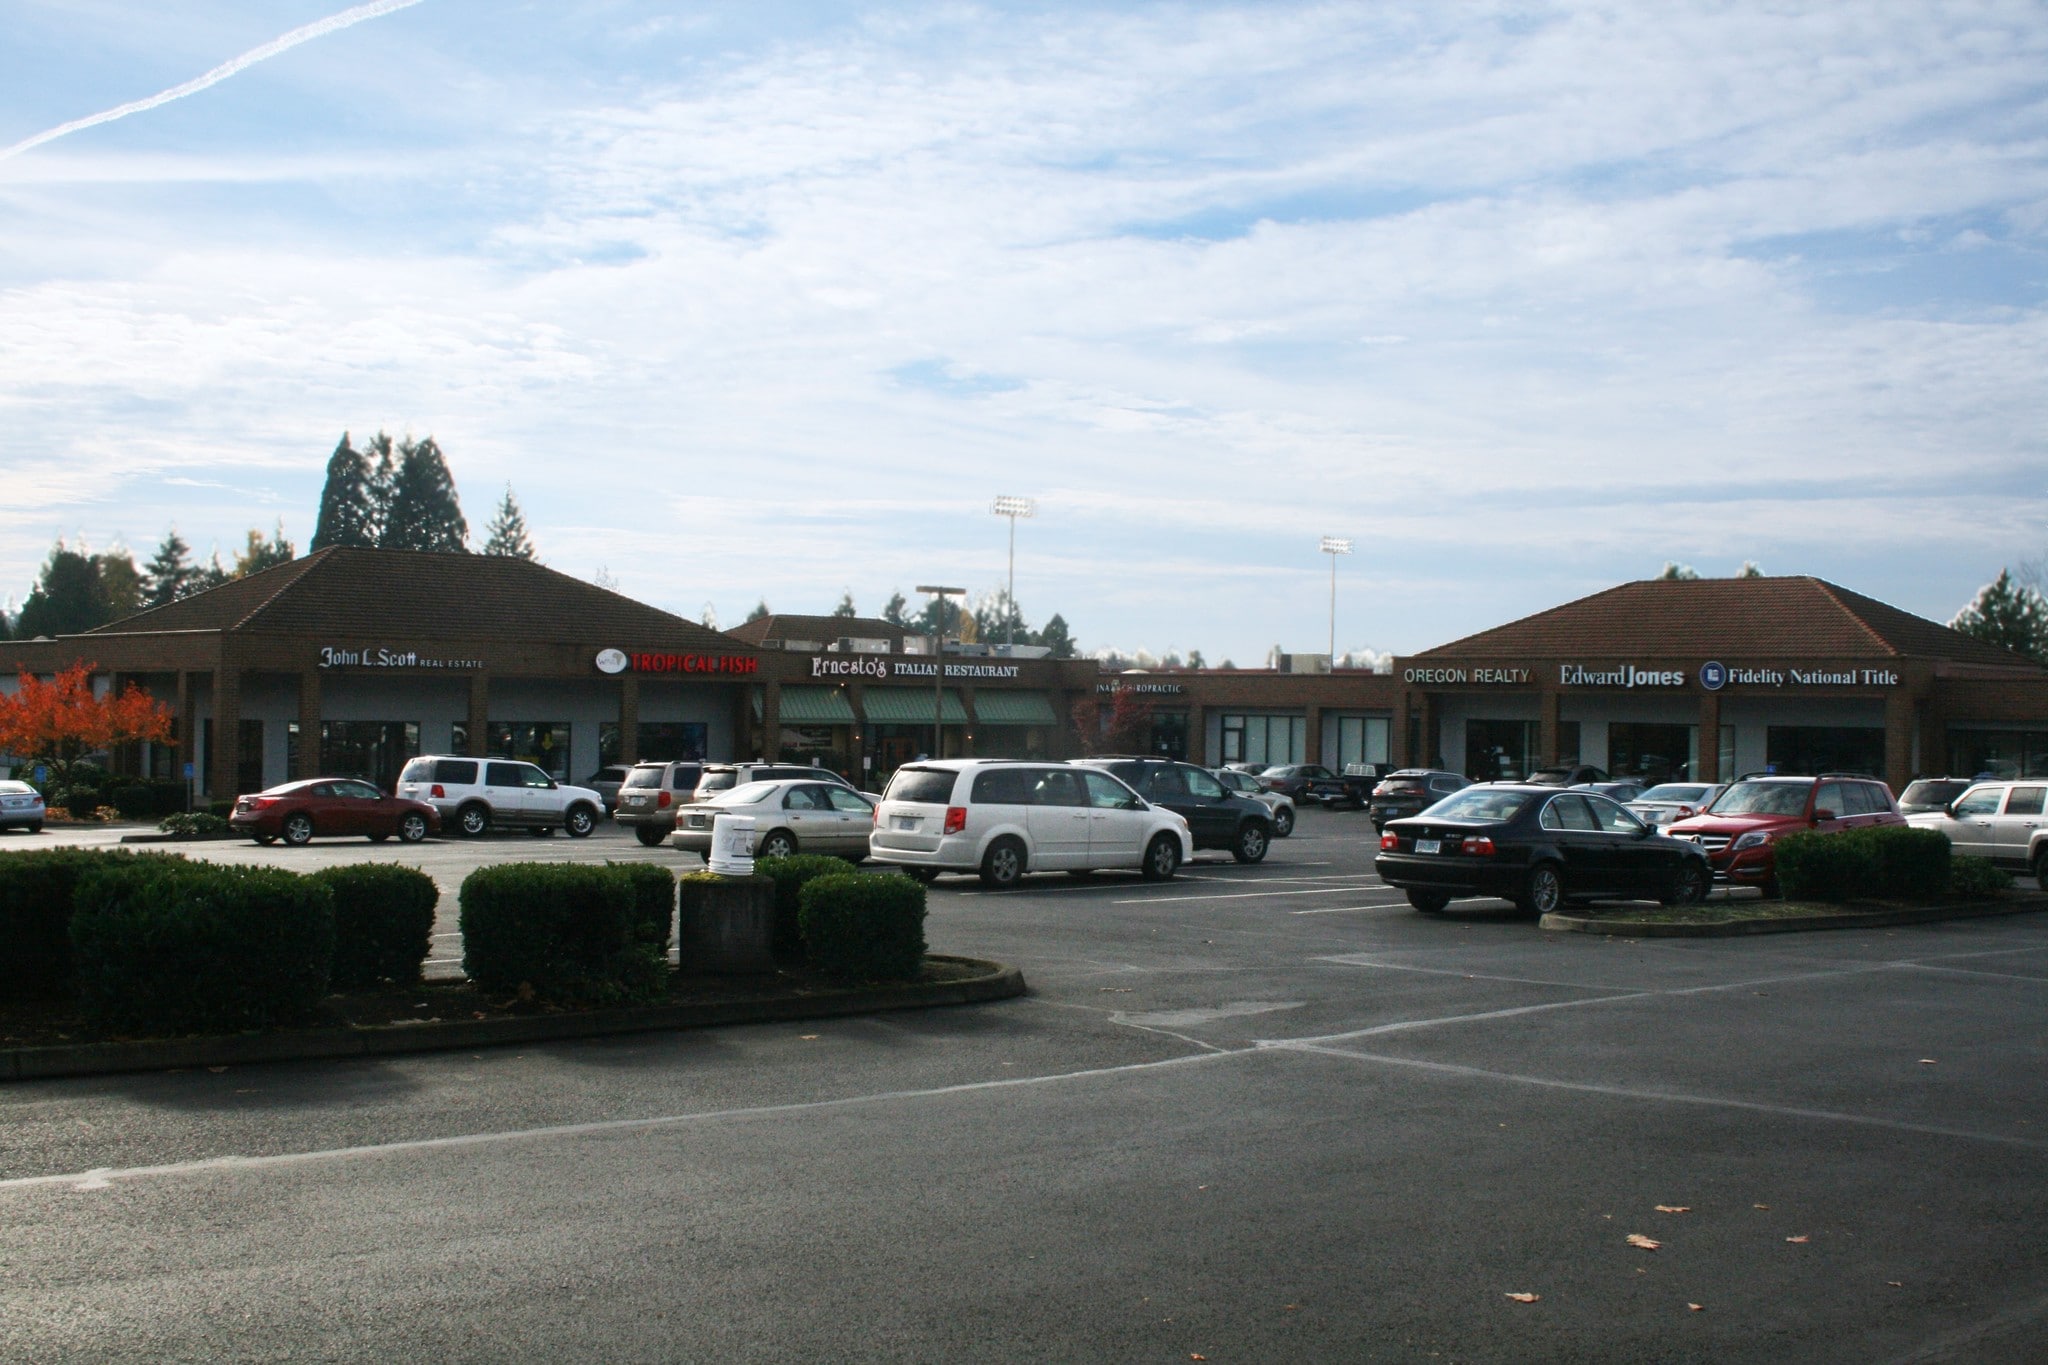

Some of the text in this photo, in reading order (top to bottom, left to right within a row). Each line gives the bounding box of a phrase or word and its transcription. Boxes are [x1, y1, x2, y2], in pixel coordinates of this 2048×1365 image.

[319, 647, 358, 667] John
[420, 659, 444, 668] REAL
[449, 660, 483, 669] ESTATE
[631, 652, 714, 673] TROPICAL
[719, 655, 759, 674] FISH
[812, 655, 887, 678] Ernesto's
[944, 664, 1019, 677] RESTAURANT
[1404, 668, 1530, 683] OREGON REALTY
[1728, 668, 1898, 687] Fidelity National Title
